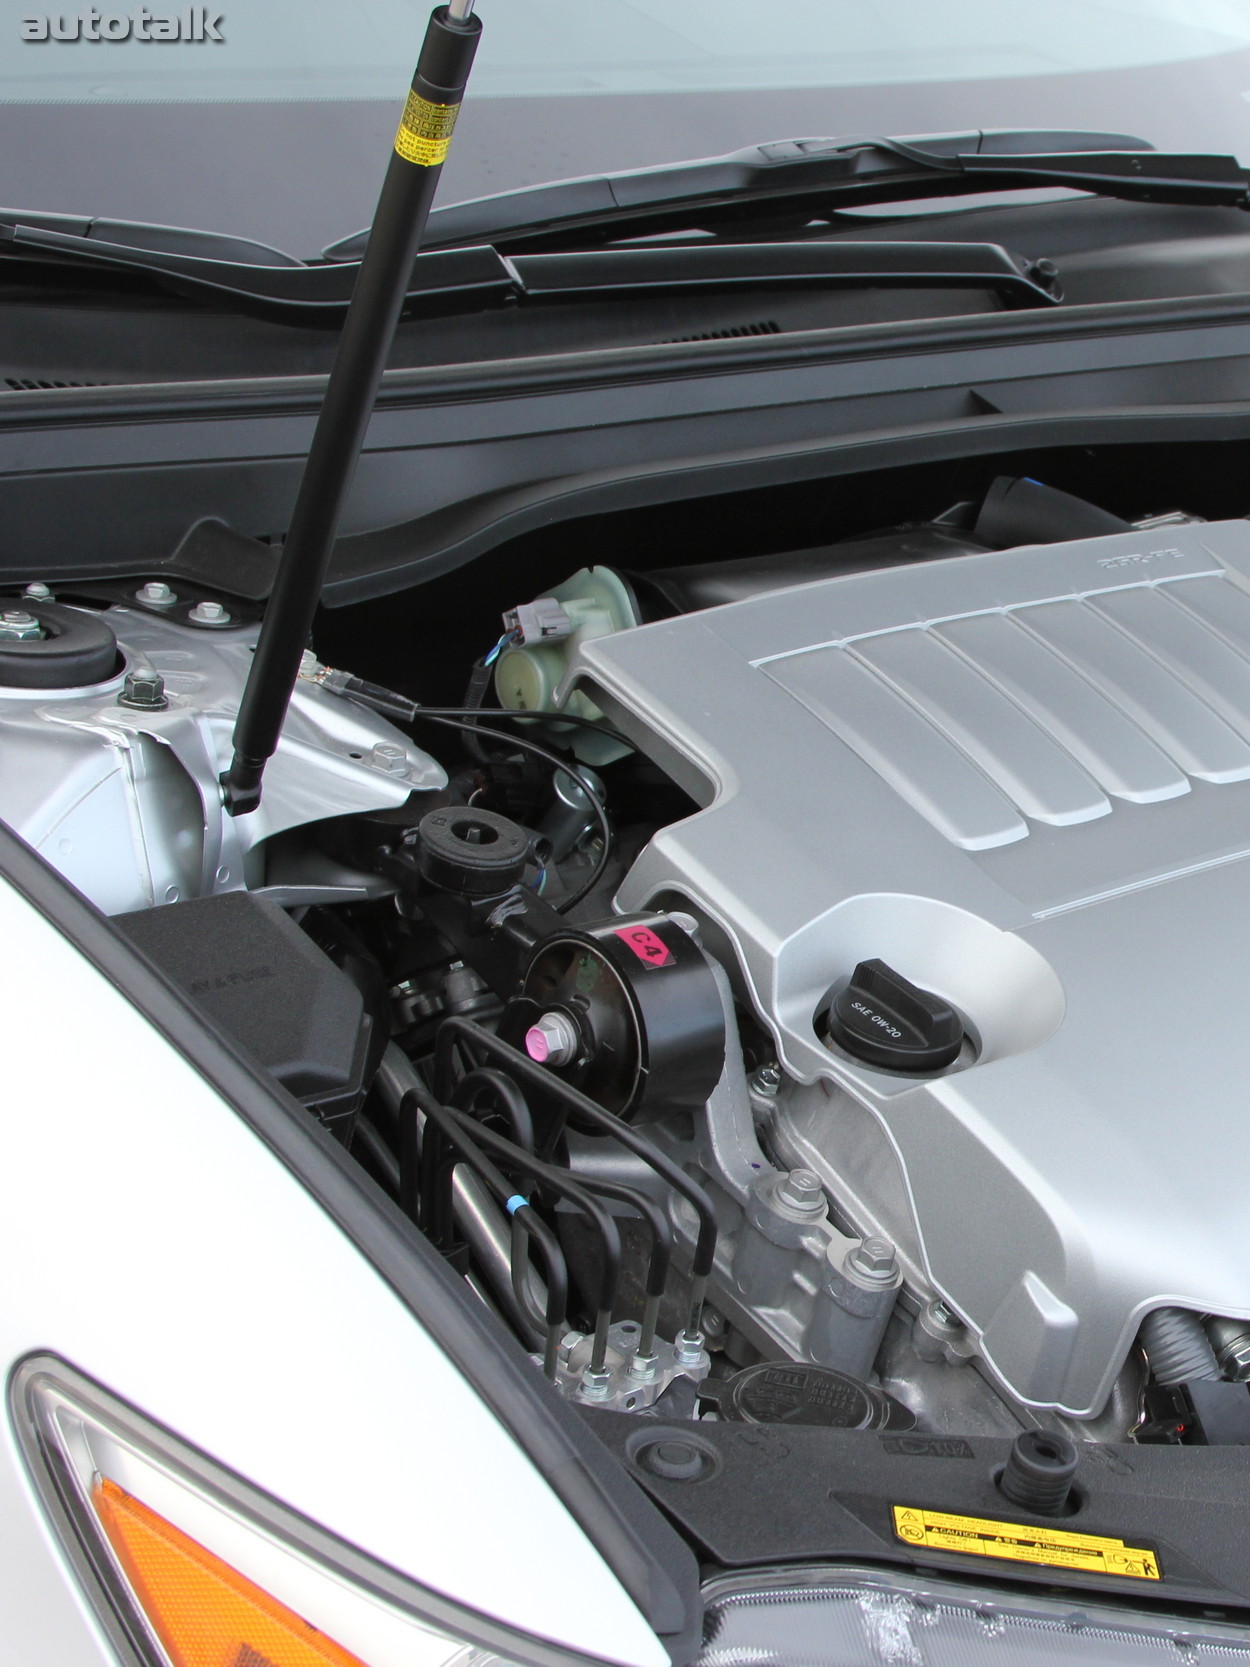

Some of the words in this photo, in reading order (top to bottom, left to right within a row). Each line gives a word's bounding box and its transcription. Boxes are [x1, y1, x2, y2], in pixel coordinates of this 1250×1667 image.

[631, 932, 663, 957] C4
[851, 1002, 873, 1016] SAE
[871, 1015, 902, 1038] 0W-20
[940, 1527, 979, 1539] CAUTION
